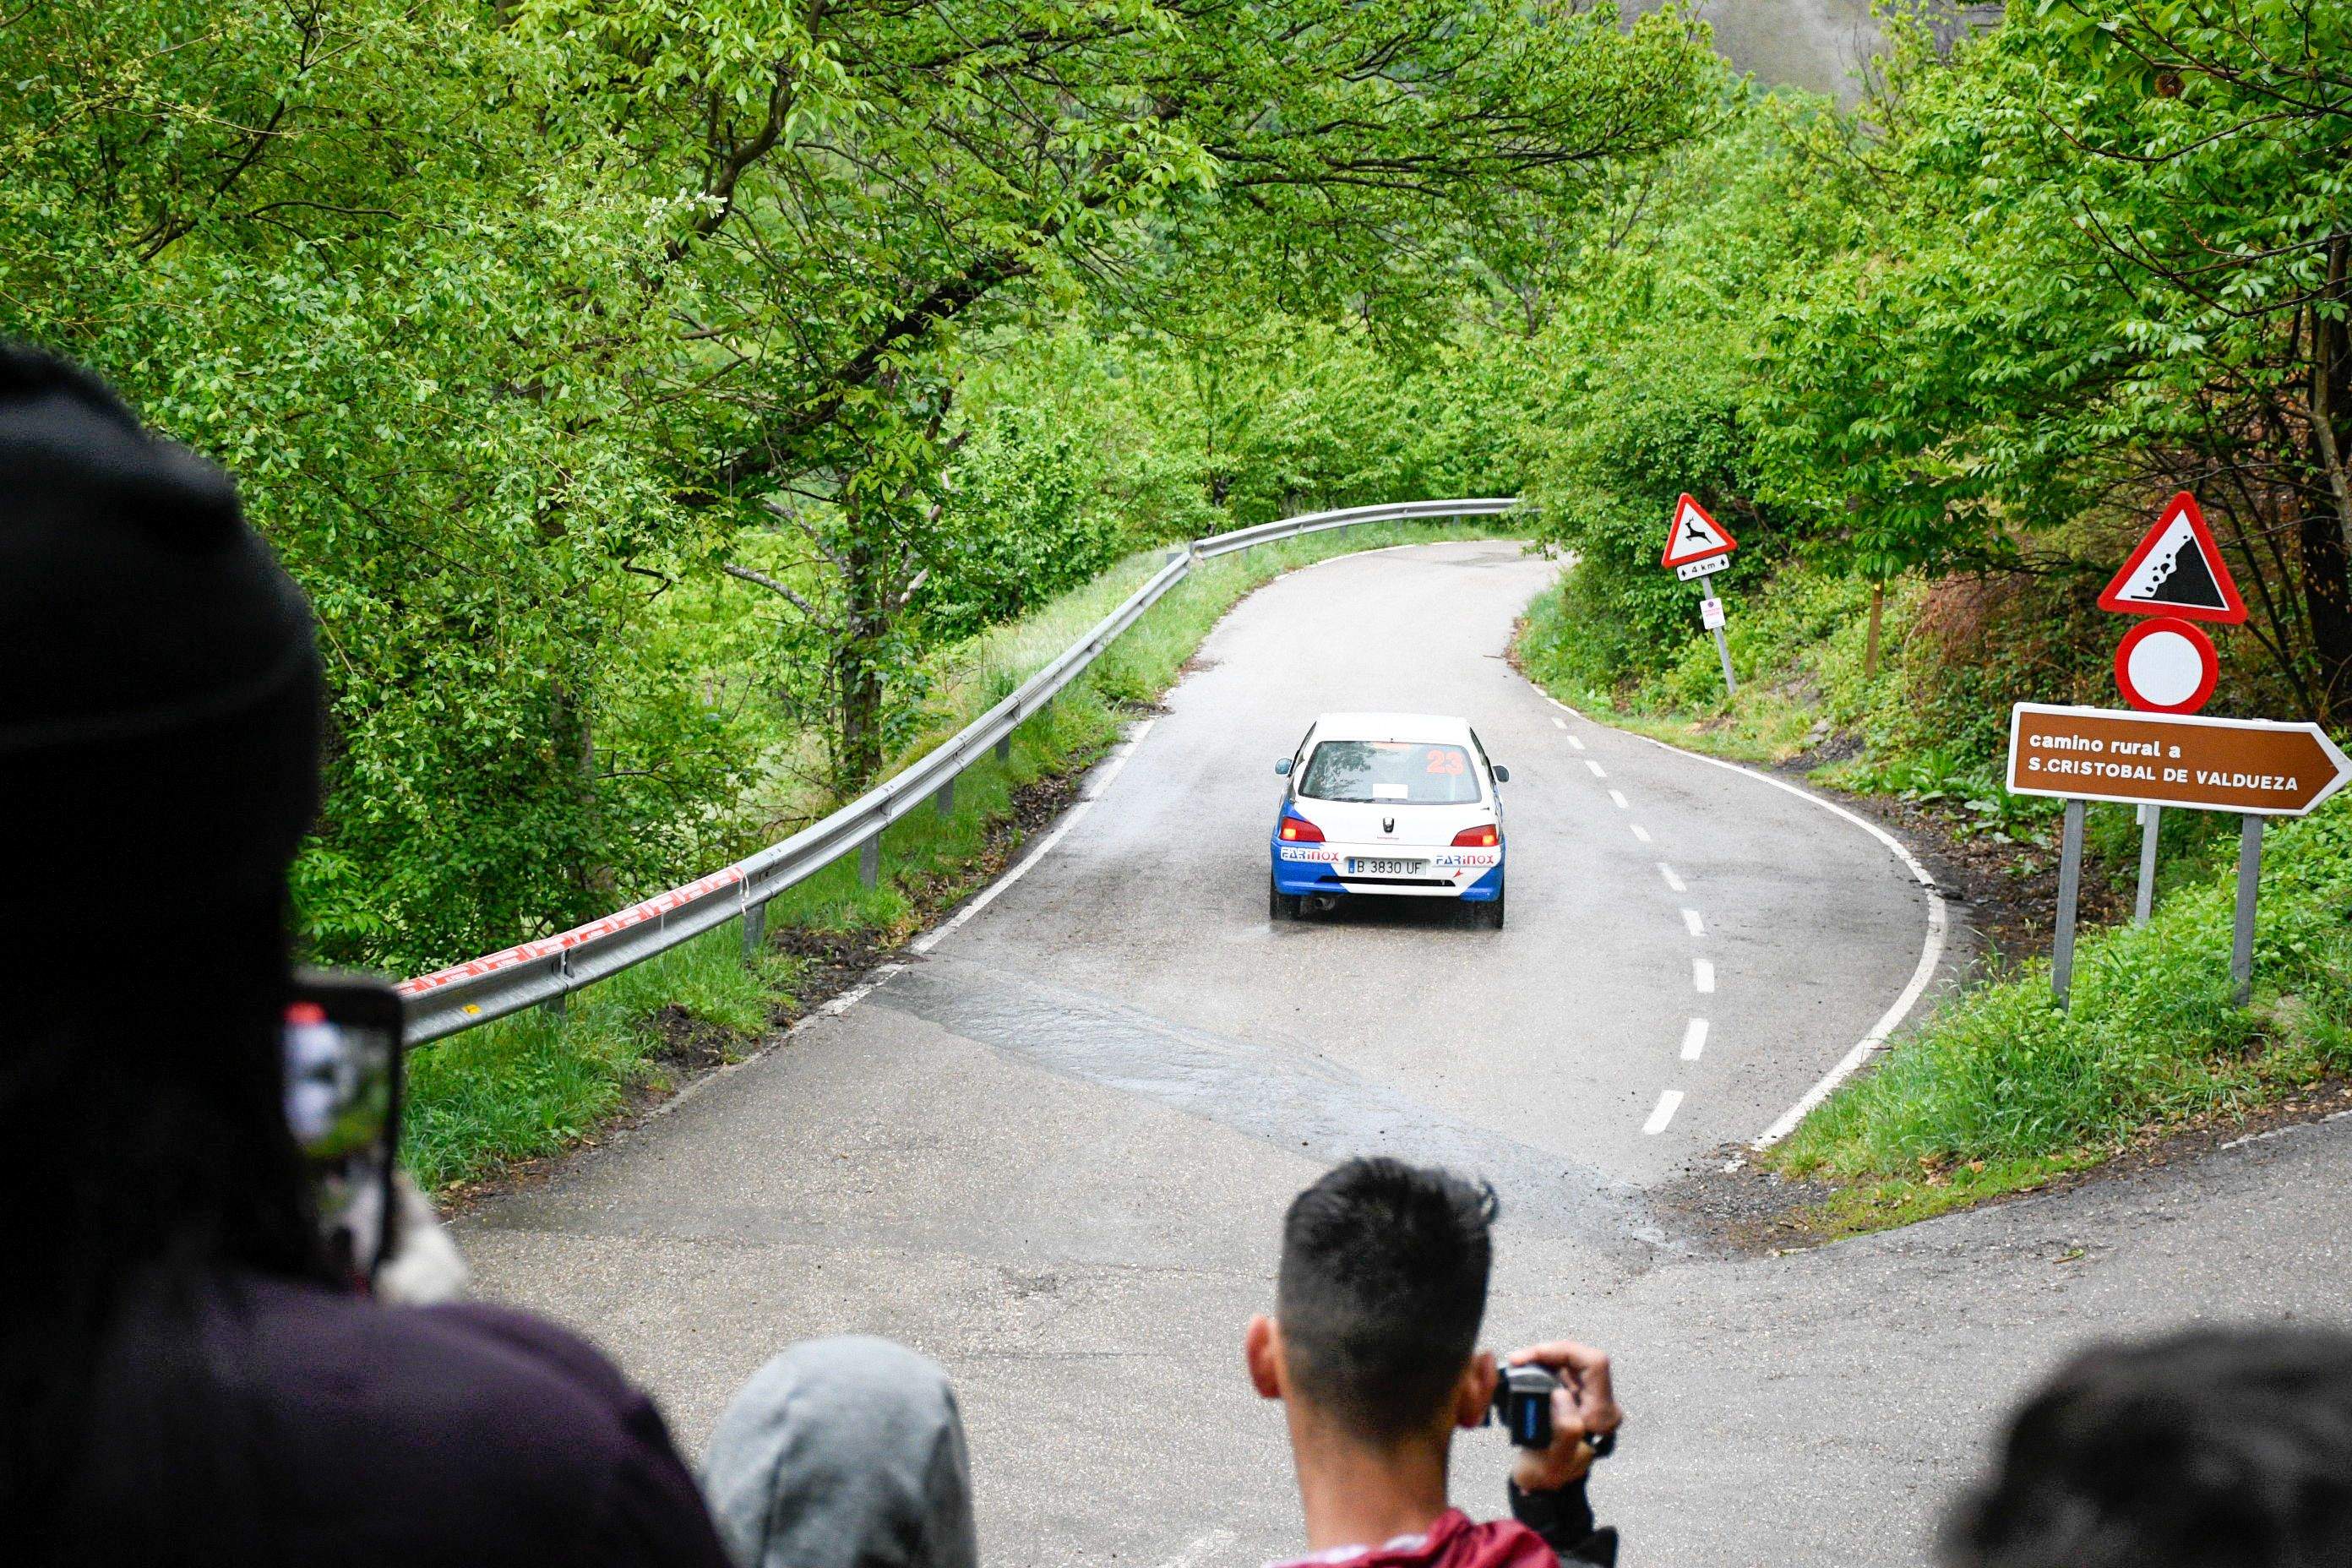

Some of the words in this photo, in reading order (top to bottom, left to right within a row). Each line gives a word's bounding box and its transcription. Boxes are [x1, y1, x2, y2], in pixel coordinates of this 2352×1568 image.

[1701, 563, 1716, 571] km
[2029, 733, 2104, 753] camino
[2110, 740, 2160, 758] rural
[2168, 744, 2181, 759] a
[1426, 749, 1464, 776] 23
[2028, 757, 2156, 781] S.CRISTOBAL
[2163, 768, 2188, 784] DE
[2196, 770, 2299, 792] VALDUEZA
[1357, 861, 1365, 873] B
[1370, 861, 1402, 874] 3830
[1407, 862, 1422, 874] UF
